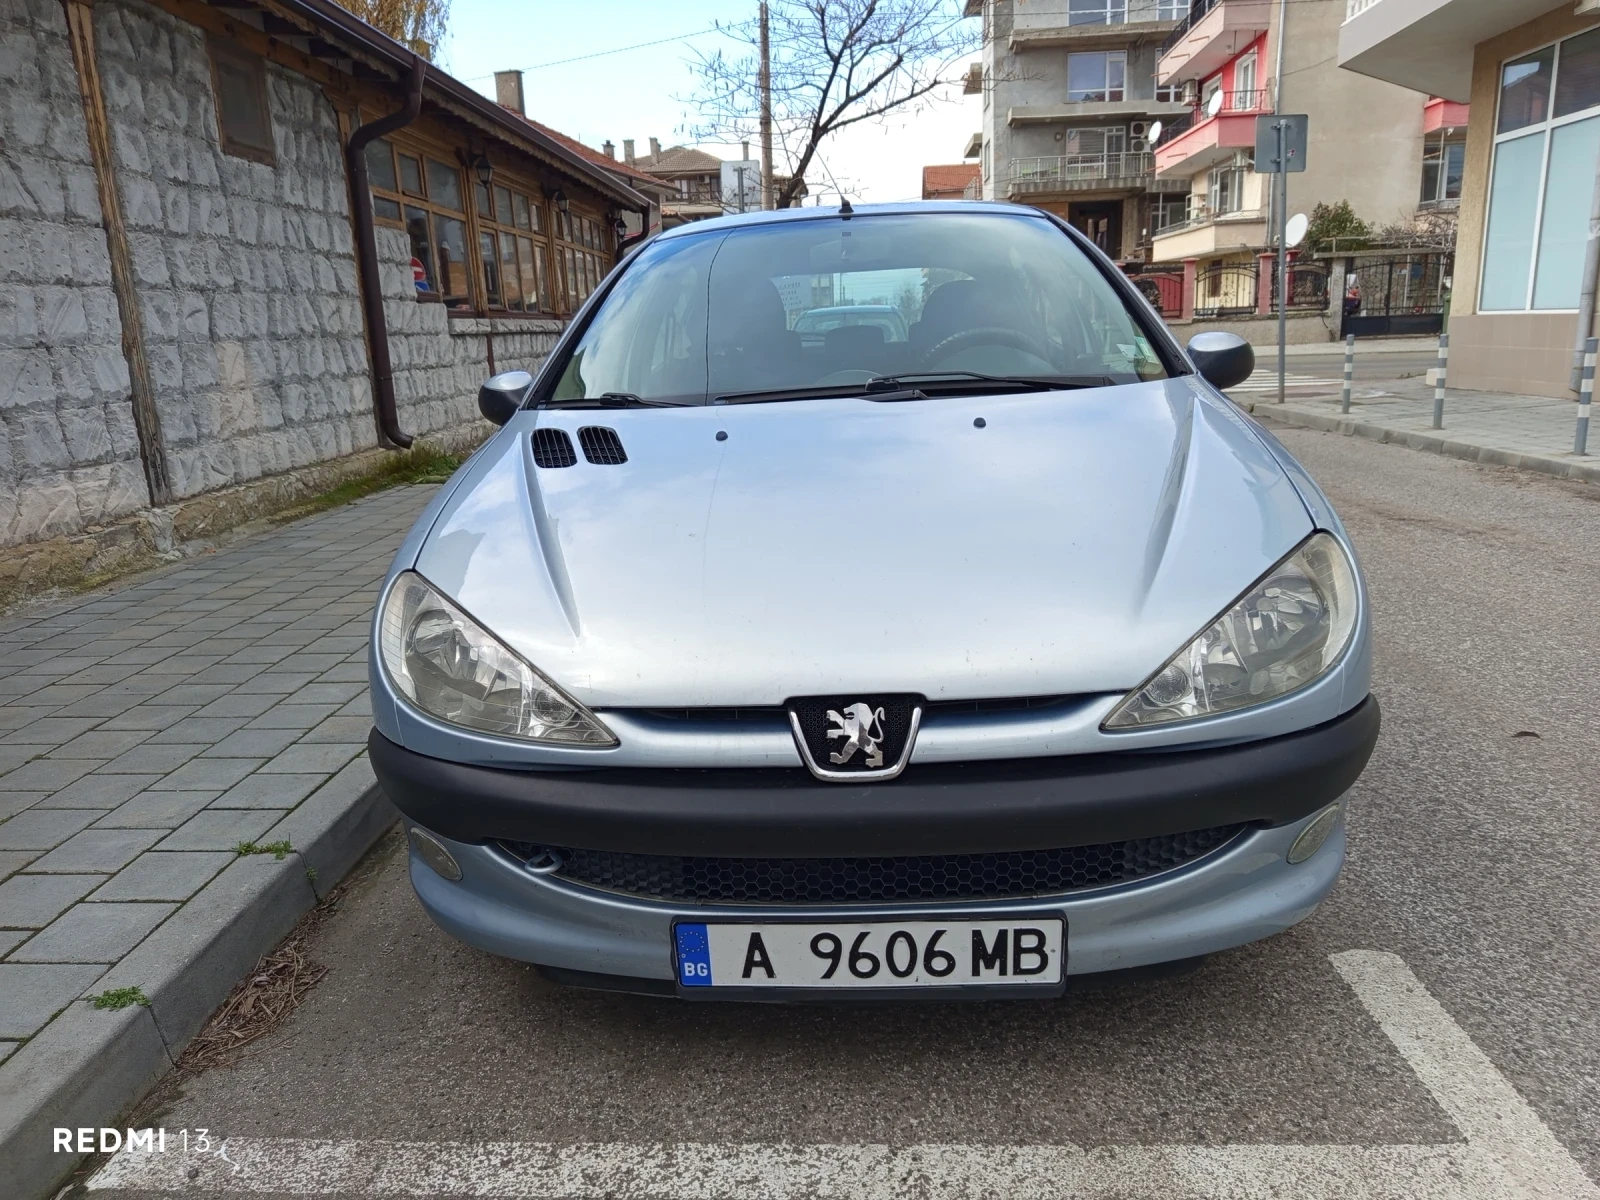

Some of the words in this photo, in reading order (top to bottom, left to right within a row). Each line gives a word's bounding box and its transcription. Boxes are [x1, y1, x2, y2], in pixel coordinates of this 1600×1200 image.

[684, 962, 708, 977] BG
[742, 932, 775, 978] A
[810, 930, 956, 979] 9606
[971, 928, 1049, 977] MB
